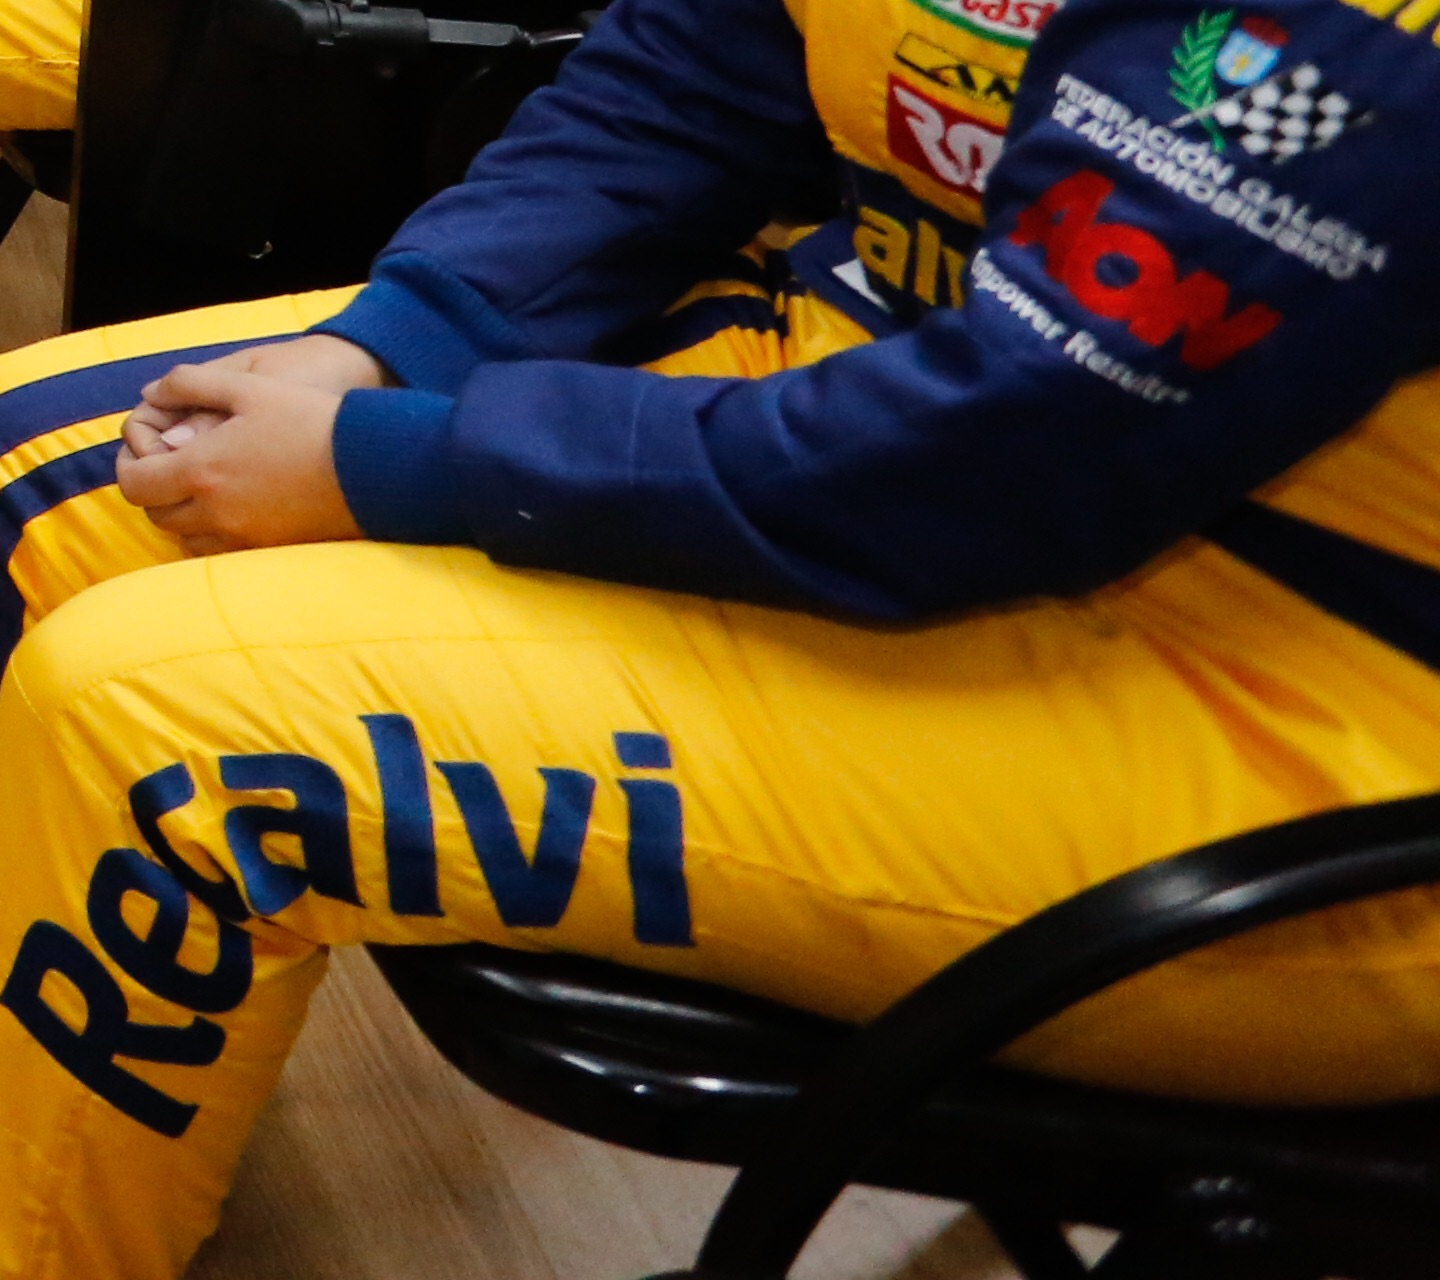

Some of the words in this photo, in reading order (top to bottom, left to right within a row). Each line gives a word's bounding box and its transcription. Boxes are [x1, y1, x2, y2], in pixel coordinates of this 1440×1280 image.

[1008, 167, 1284, 372] AON
[1052, 97, 1080, 127] DE
[1077, 116, 1360, 281] AUTOMOBILISMO
[1055, 73, 1235, 186] FEDERACIÓN
[1238, 177, 1388, 272] GALEGA
